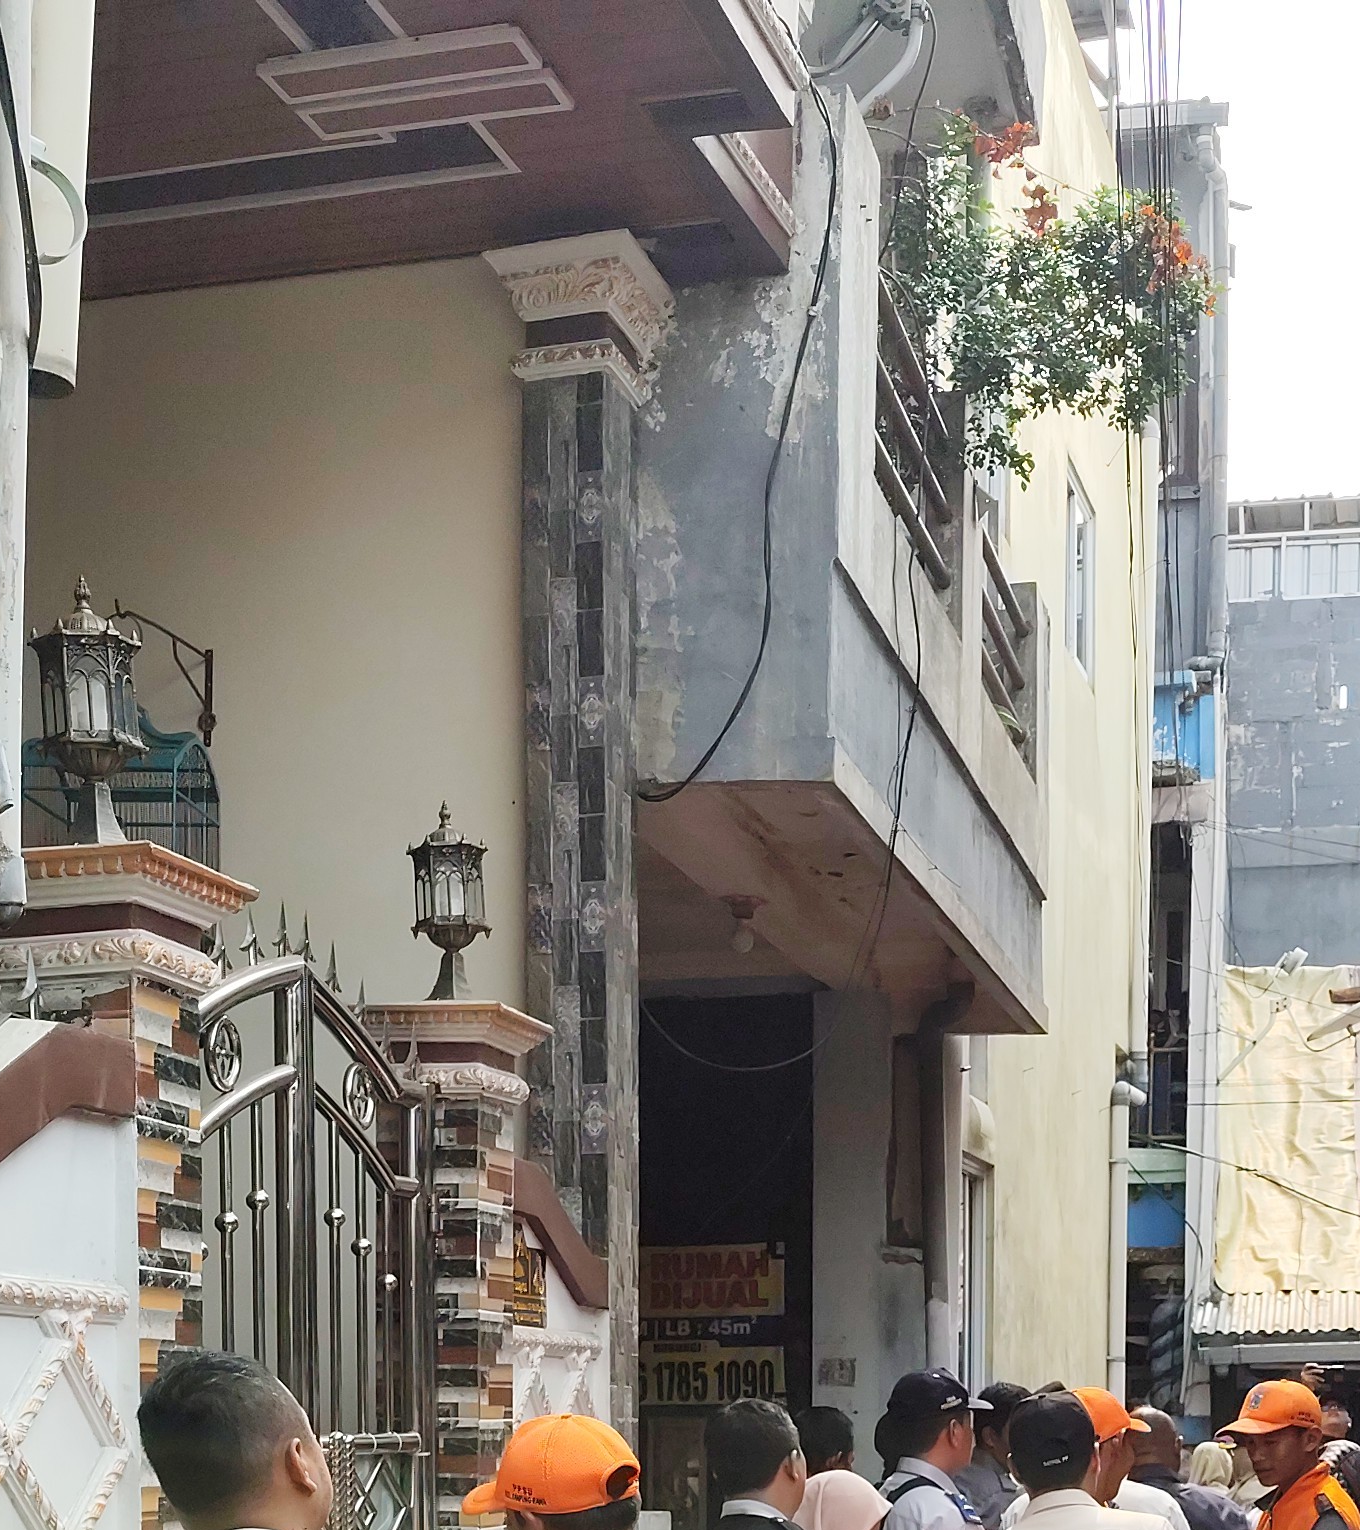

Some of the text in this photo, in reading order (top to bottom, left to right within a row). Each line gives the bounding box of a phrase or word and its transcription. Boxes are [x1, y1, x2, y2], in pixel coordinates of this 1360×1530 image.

[651, 1251, 768, 1280] RUMAH
[651, 1280, 768, 1309] DIJUAL
[665, 1320, 690, 1336] LB
[653, 1361, 708, 1401] 1785
[714, 1360, 774, 1401] 1090
